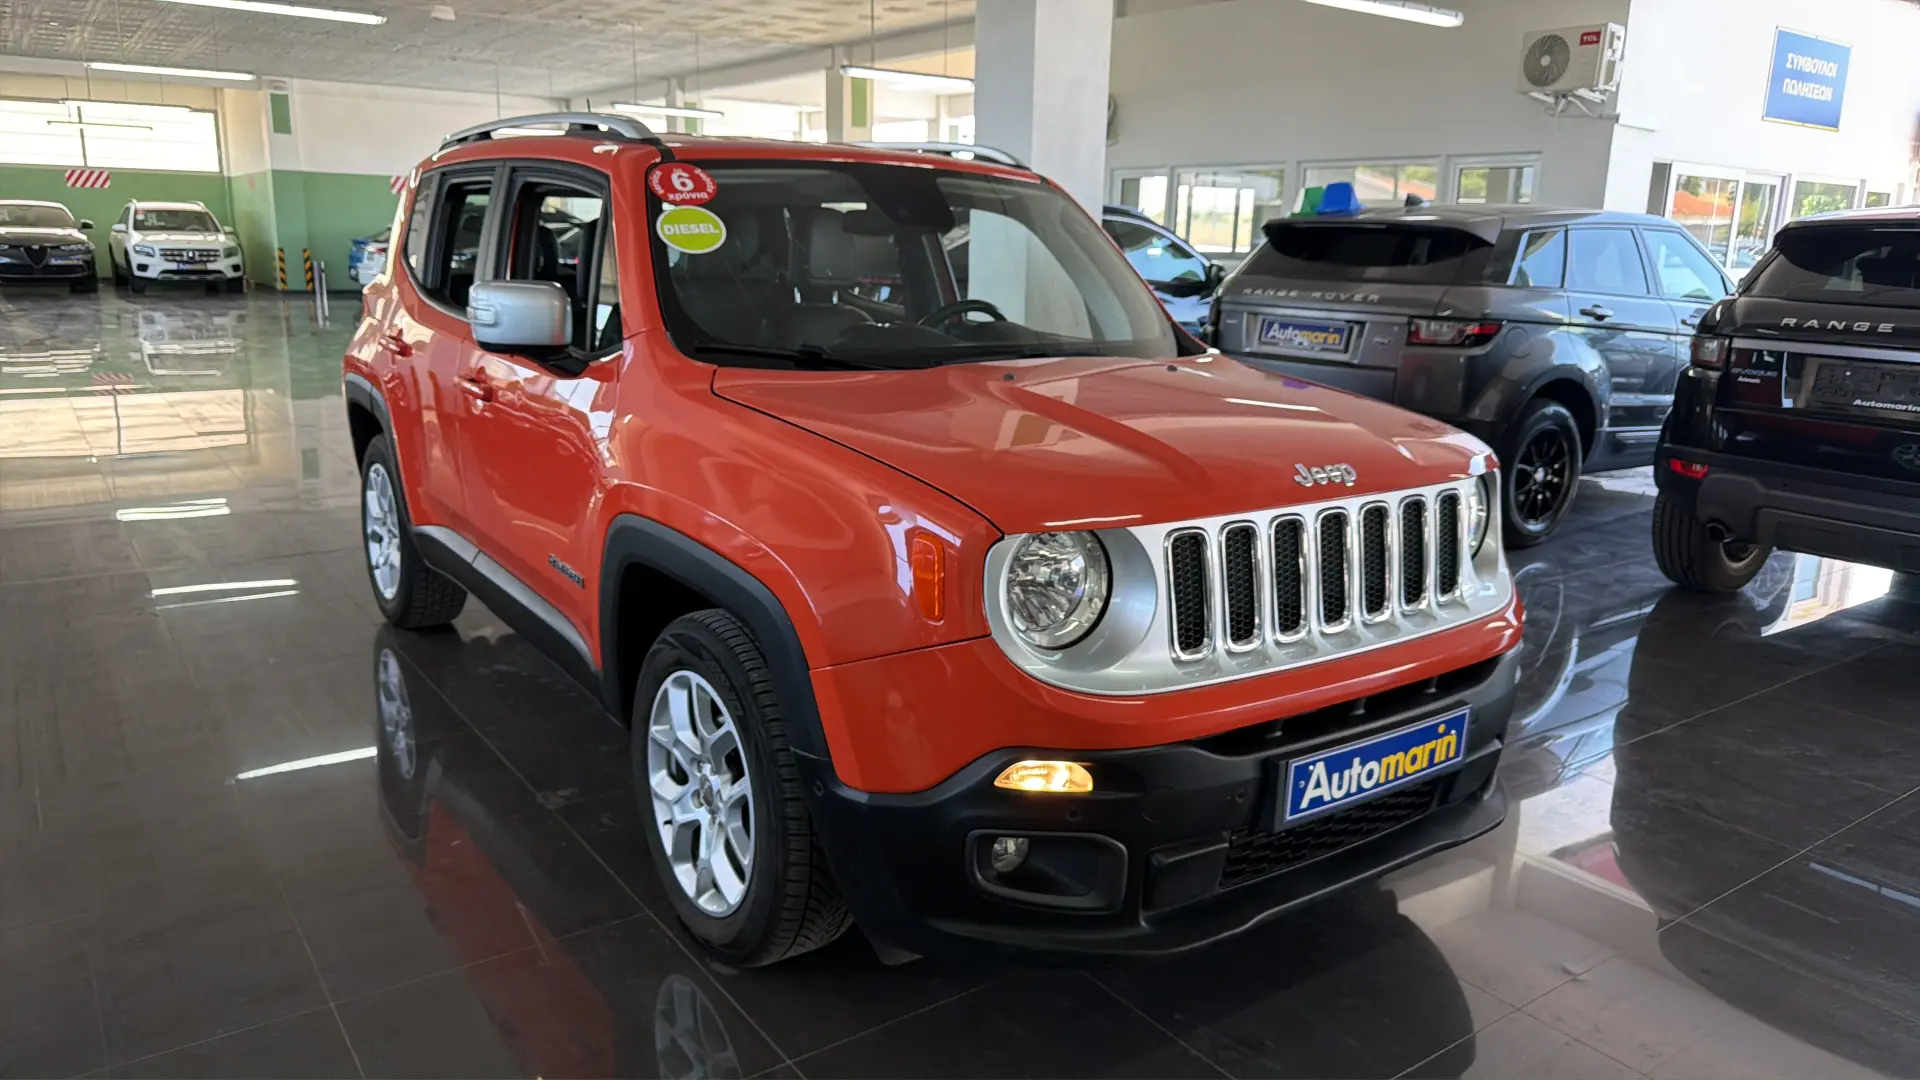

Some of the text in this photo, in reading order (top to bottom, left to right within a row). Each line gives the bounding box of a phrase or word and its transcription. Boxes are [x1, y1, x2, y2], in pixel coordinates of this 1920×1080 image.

[671, 171, 694, 192] 6
[663, 223, 720, 235] DIESEL
[1242, 288, 1380, 303] RANGE ROVER
[1267, 322, 1341, 344] Automarin
[1780, 317, 1896, 333] RANGE
[1294, 463, 1357, 487] Jeep
[1299, 723, 1458, 810] Automarin
